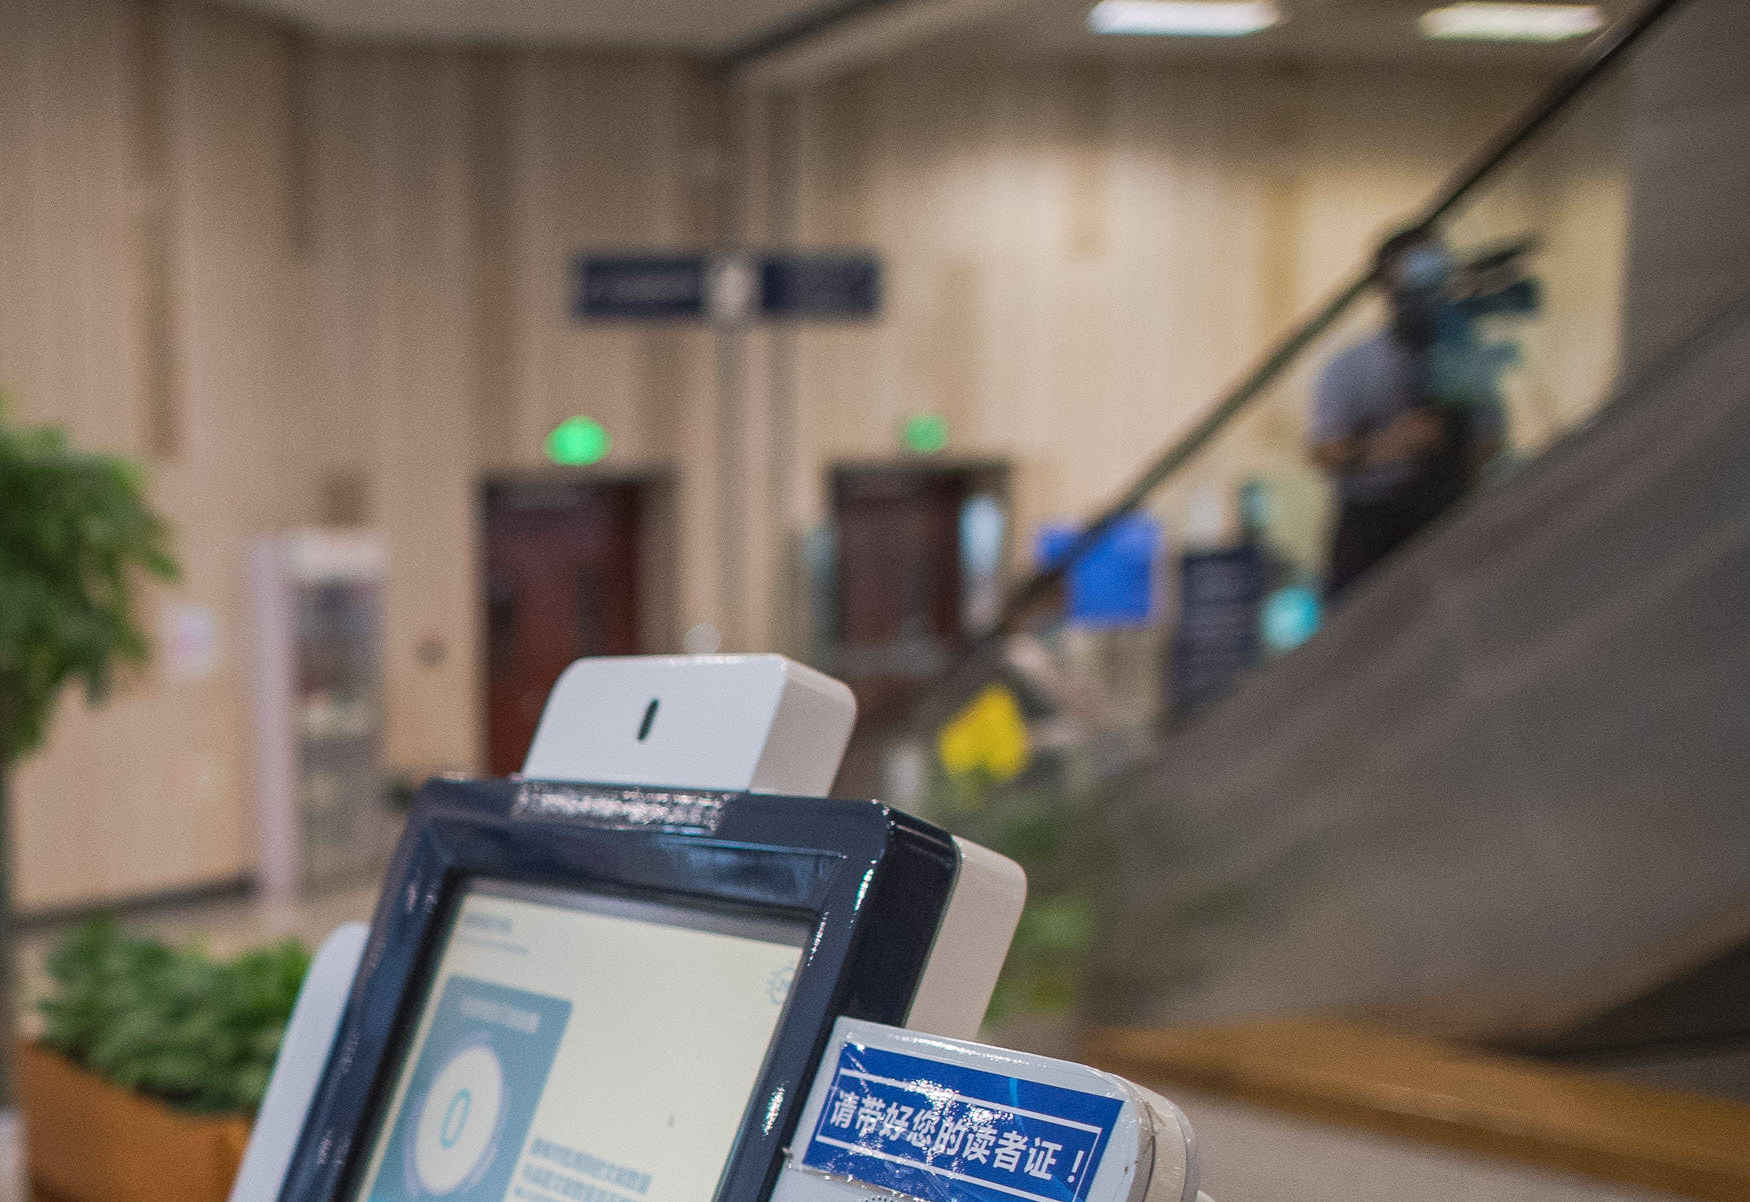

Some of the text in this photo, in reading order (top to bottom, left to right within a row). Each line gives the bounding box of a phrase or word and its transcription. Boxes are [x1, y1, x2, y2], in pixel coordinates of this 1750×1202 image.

[830, 1090, 1085, 1184] 请带好您的读者证！
